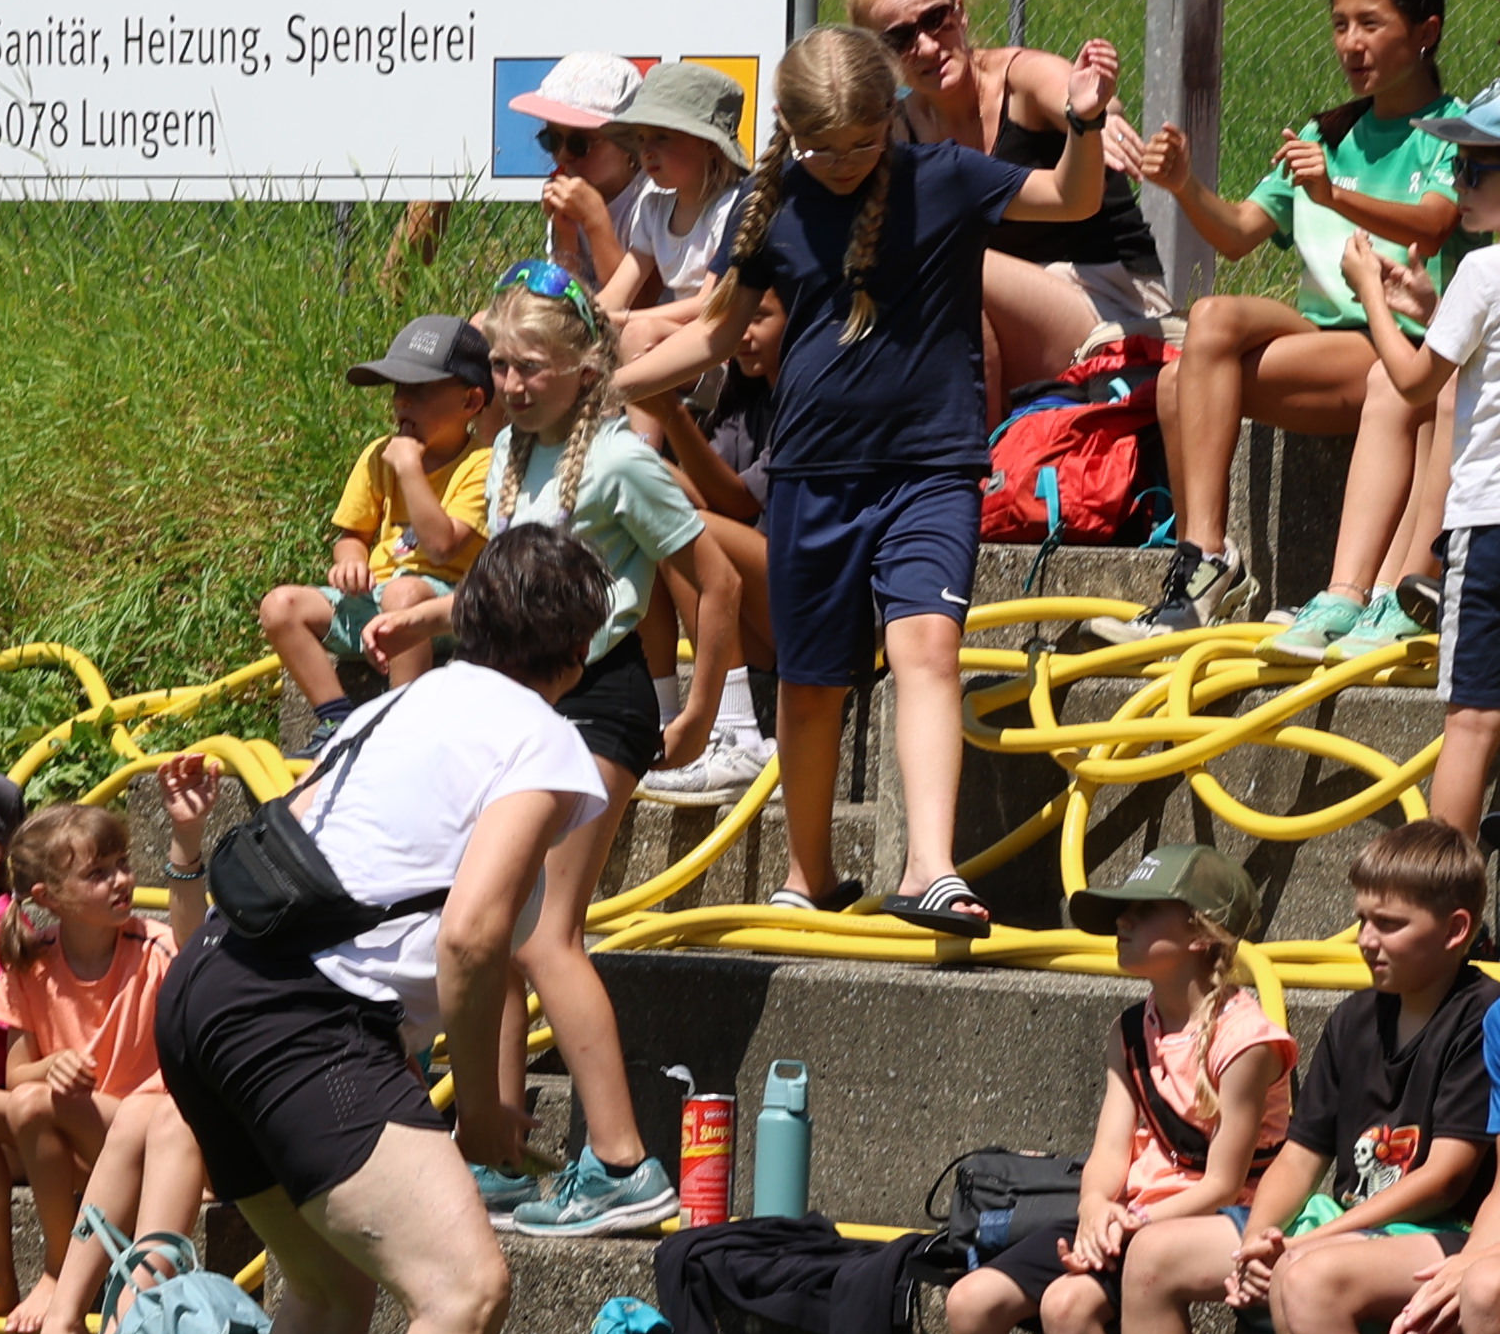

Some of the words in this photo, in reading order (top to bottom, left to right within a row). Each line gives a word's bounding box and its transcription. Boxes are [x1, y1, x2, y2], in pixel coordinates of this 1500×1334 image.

[123, 13, 273, 76] Heizung,
[285, 10, 477, 78] Spenglerei
[81, 97, 217, 159] Lungern
